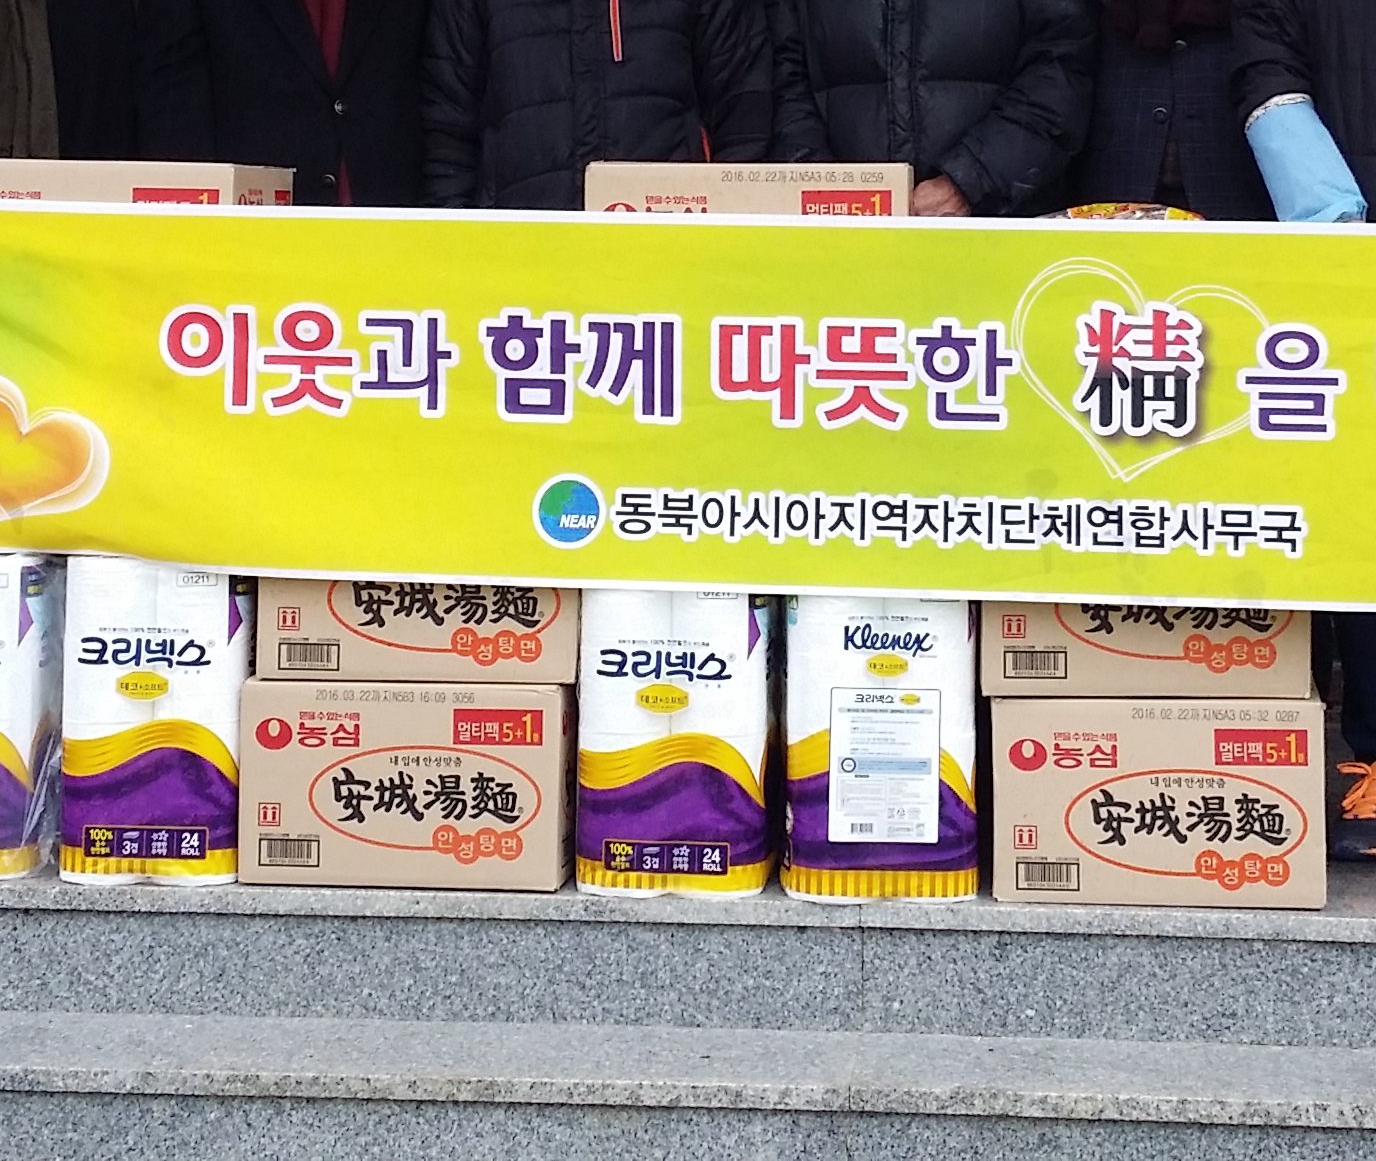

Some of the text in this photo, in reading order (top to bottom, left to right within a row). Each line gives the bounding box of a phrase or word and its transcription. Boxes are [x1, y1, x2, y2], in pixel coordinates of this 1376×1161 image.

[165, 308, 453, 412] 이웃과
[484, 313, 676, 419] 함께
[717, 321, 1015, 425] 따뜻한
[1079, 306, 1205, 437] 精
[1243, 329, 1341, 435] 을
[558, 513, 597, 530] NEAR
[614, 491, 1303, 554] 동북아시아지역자치단체연합사무국
[182, 575, 210, 584] 01211
[456, 632, 536, 660] 안성탕면
[843, 622, 934, 658] Kleenex
[77, 636, 212, 669] 크리넥스
[1187, 639, 1271, 669] 안성탕면
[596, 648, 733, 682] 크리넥스
[854, 693, 895, 704] 크리넥스
[296, 721, 361, 748] 농심
[457, 721, 500, 742] 멀티팩
[1051, 742, 1118, 769] 농심
[1219, 741, 1263, 763] 멀티팩
[89, 828, 113, 840] 100%
[181, 832, 200, 848] 24
[437, 831, 518, 859] 안성탕면
[180, 847, 201, 856] ROLL
[609, 842, 634, 855] 100%
[702, 847, 721, 863] 24
[702, 863, 723, 872] ROLL
[1199, 856, 1284, 886] 안성탕면
